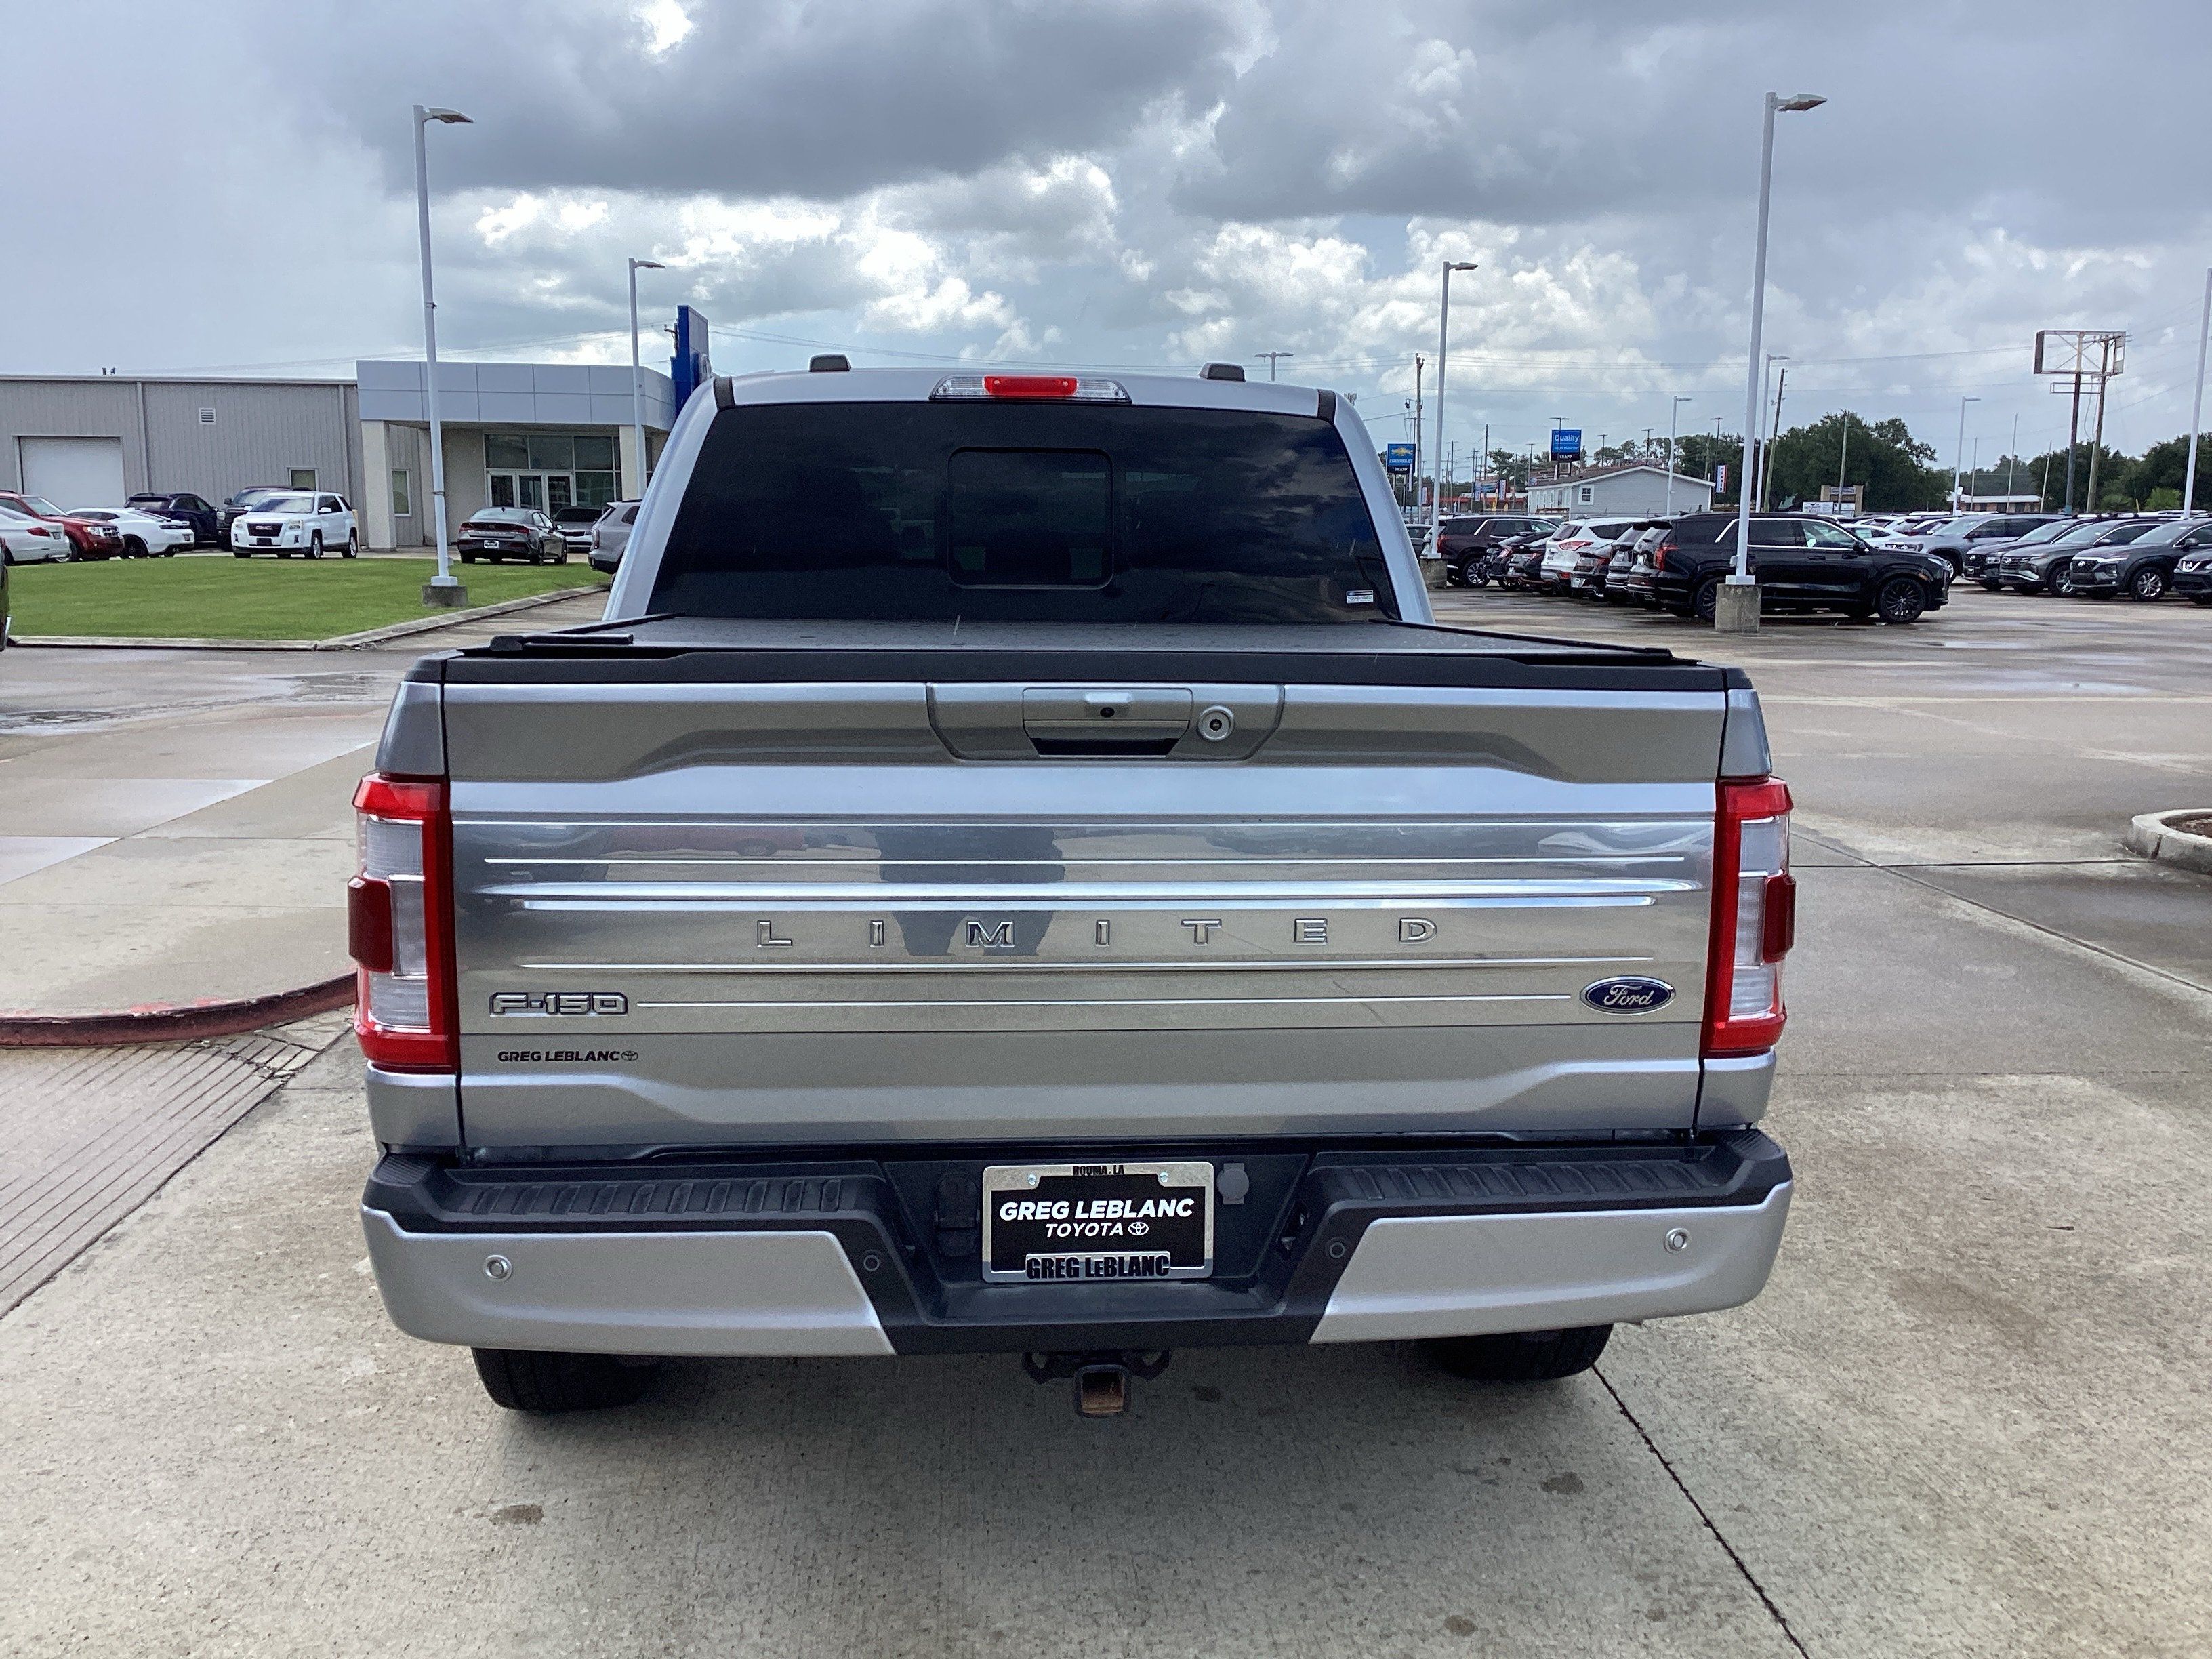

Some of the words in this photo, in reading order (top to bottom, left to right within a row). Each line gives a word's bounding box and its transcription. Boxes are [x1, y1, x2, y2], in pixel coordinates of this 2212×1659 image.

[1554, 434, 1580, 443] Quality
[756, 916, 1437, 949] LIMITED
[489, 992, 628, 1017] F-150
[1603, 985, 1654, 1006] Ford
[497, 1050, 541, 1062] GREG
[544, 1050, 620, 1062] LEBLANC
[1113, 1165, 1124, 1175] LA
[1000, 1201, 1070, 1221] GREG
[1074, 1198, 1195, 1219] LEBLANC
[1046, 1223, 1124, 1237] TOYOTA
[1027, 1256, 1080, 1279] GREG
